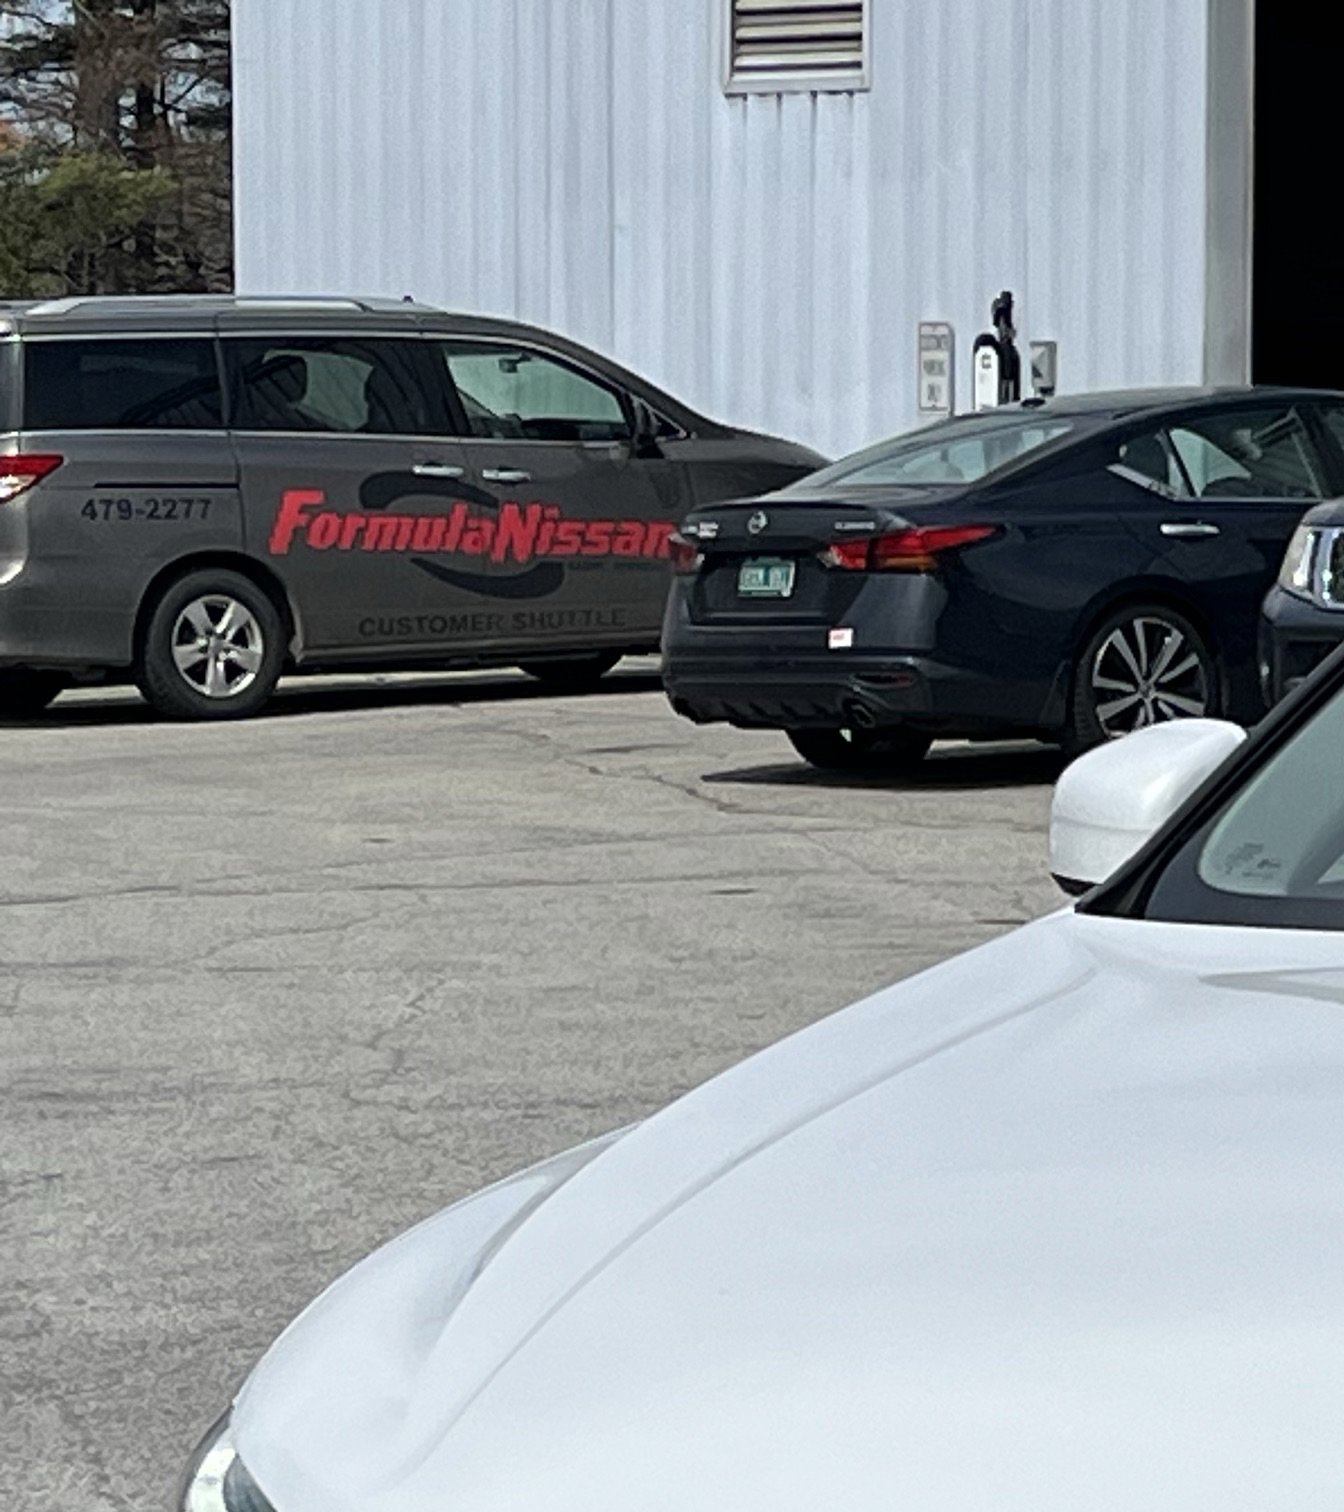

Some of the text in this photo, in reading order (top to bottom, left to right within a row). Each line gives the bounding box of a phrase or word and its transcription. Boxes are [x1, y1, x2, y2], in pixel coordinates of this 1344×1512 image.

[81, 498, 212, 521] 479-2277
[358, 608, 626, 637] CUSTOMER SHUTTLE
